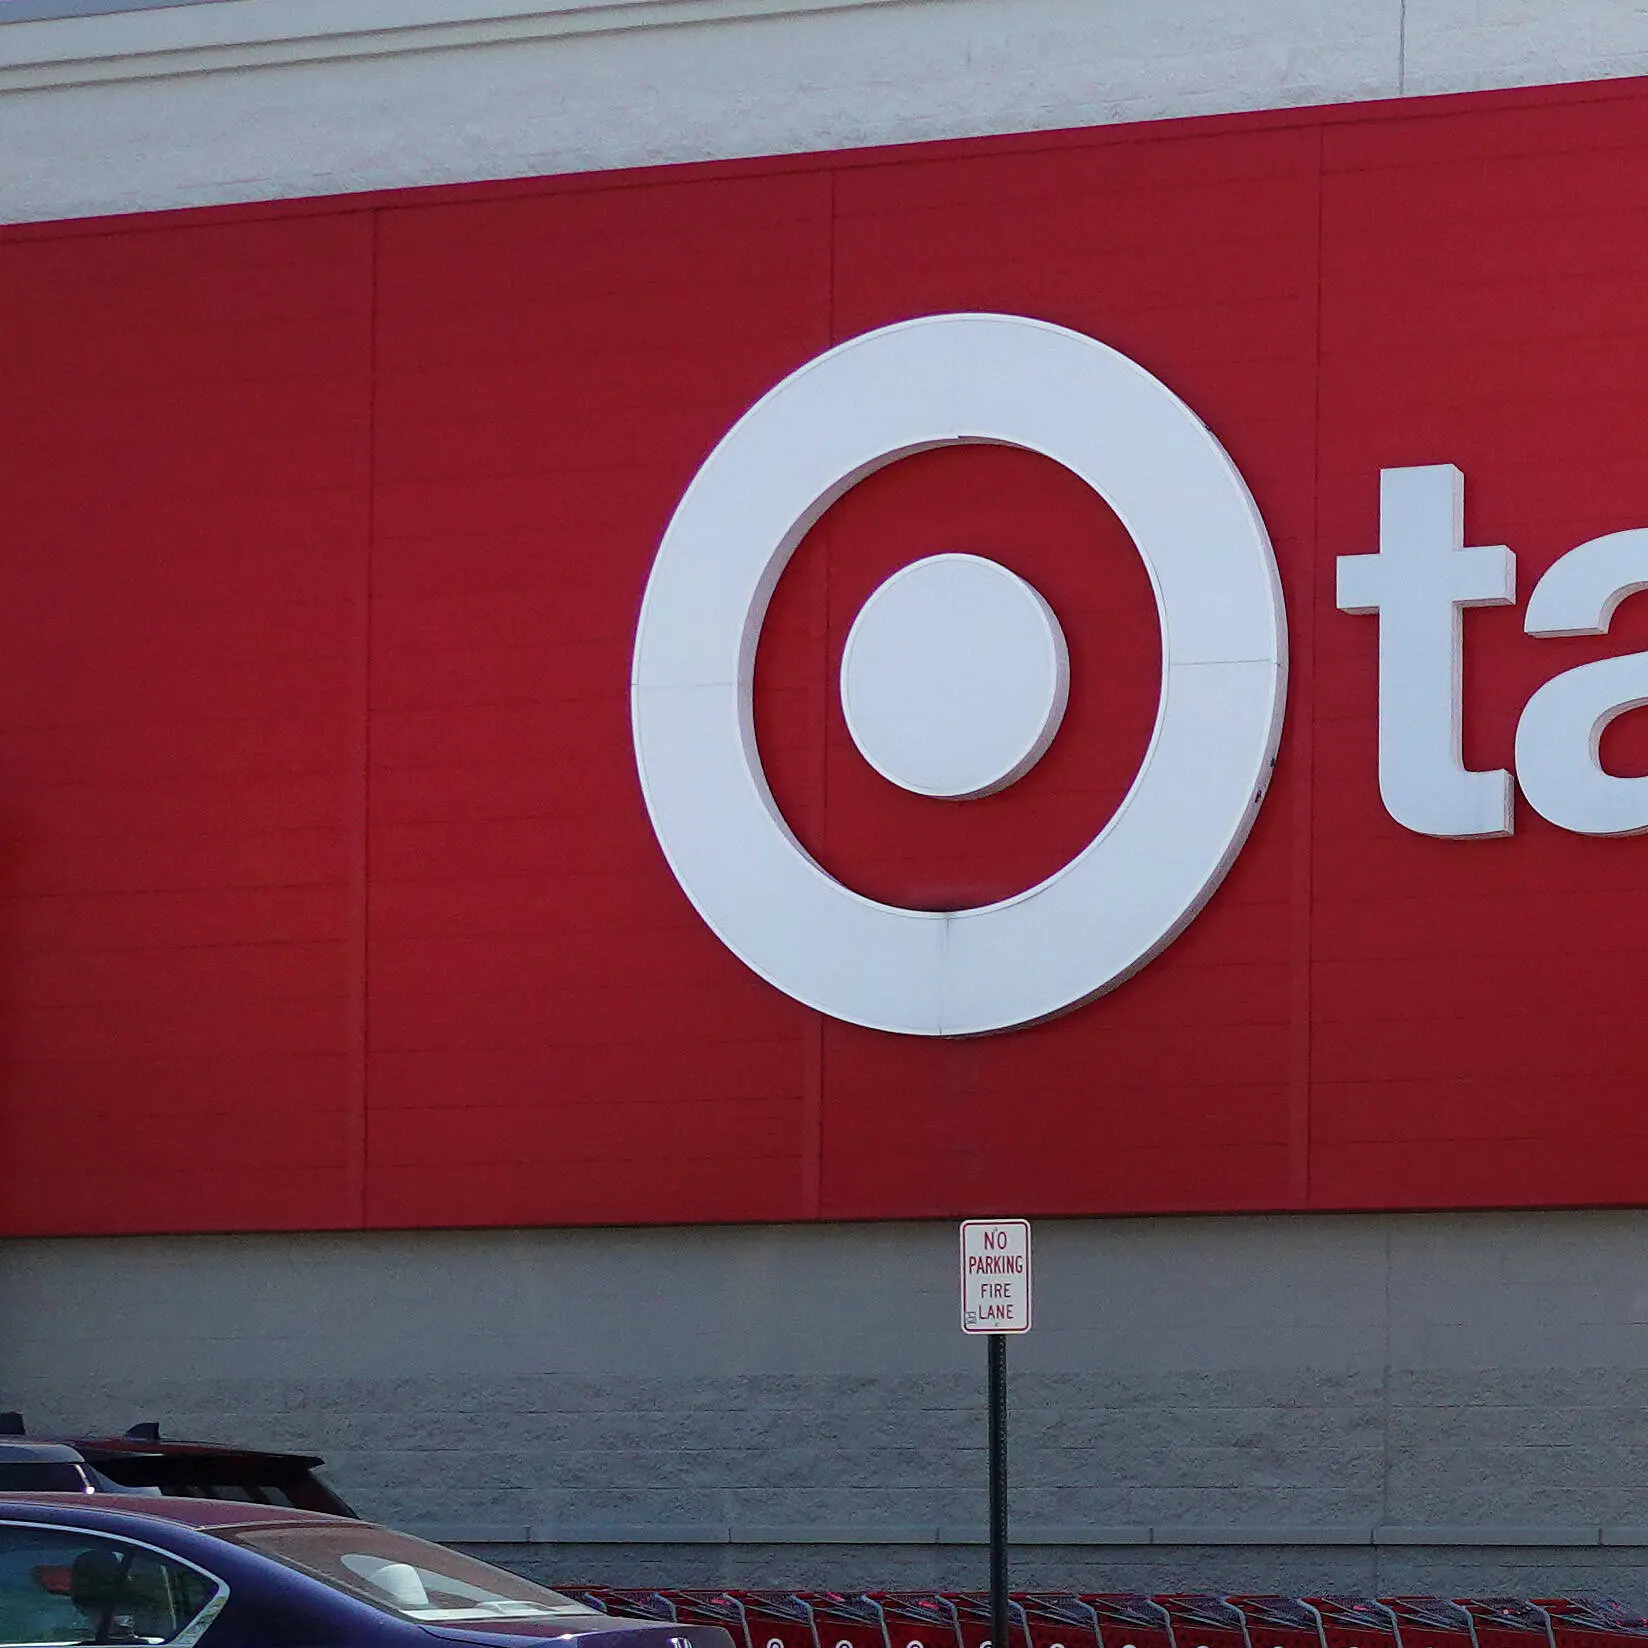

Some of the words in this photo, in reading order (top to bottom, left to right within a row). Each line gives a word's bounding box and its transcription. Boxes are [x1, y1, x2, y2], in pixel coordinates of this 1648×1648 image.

[984, 1231, 1007, 1250] NO
[969, 1255, 1024, 1274] PARKING
[981, 1283, 1012, 1298] FIRE
[978, 1304, 1014, 1319] LANE
